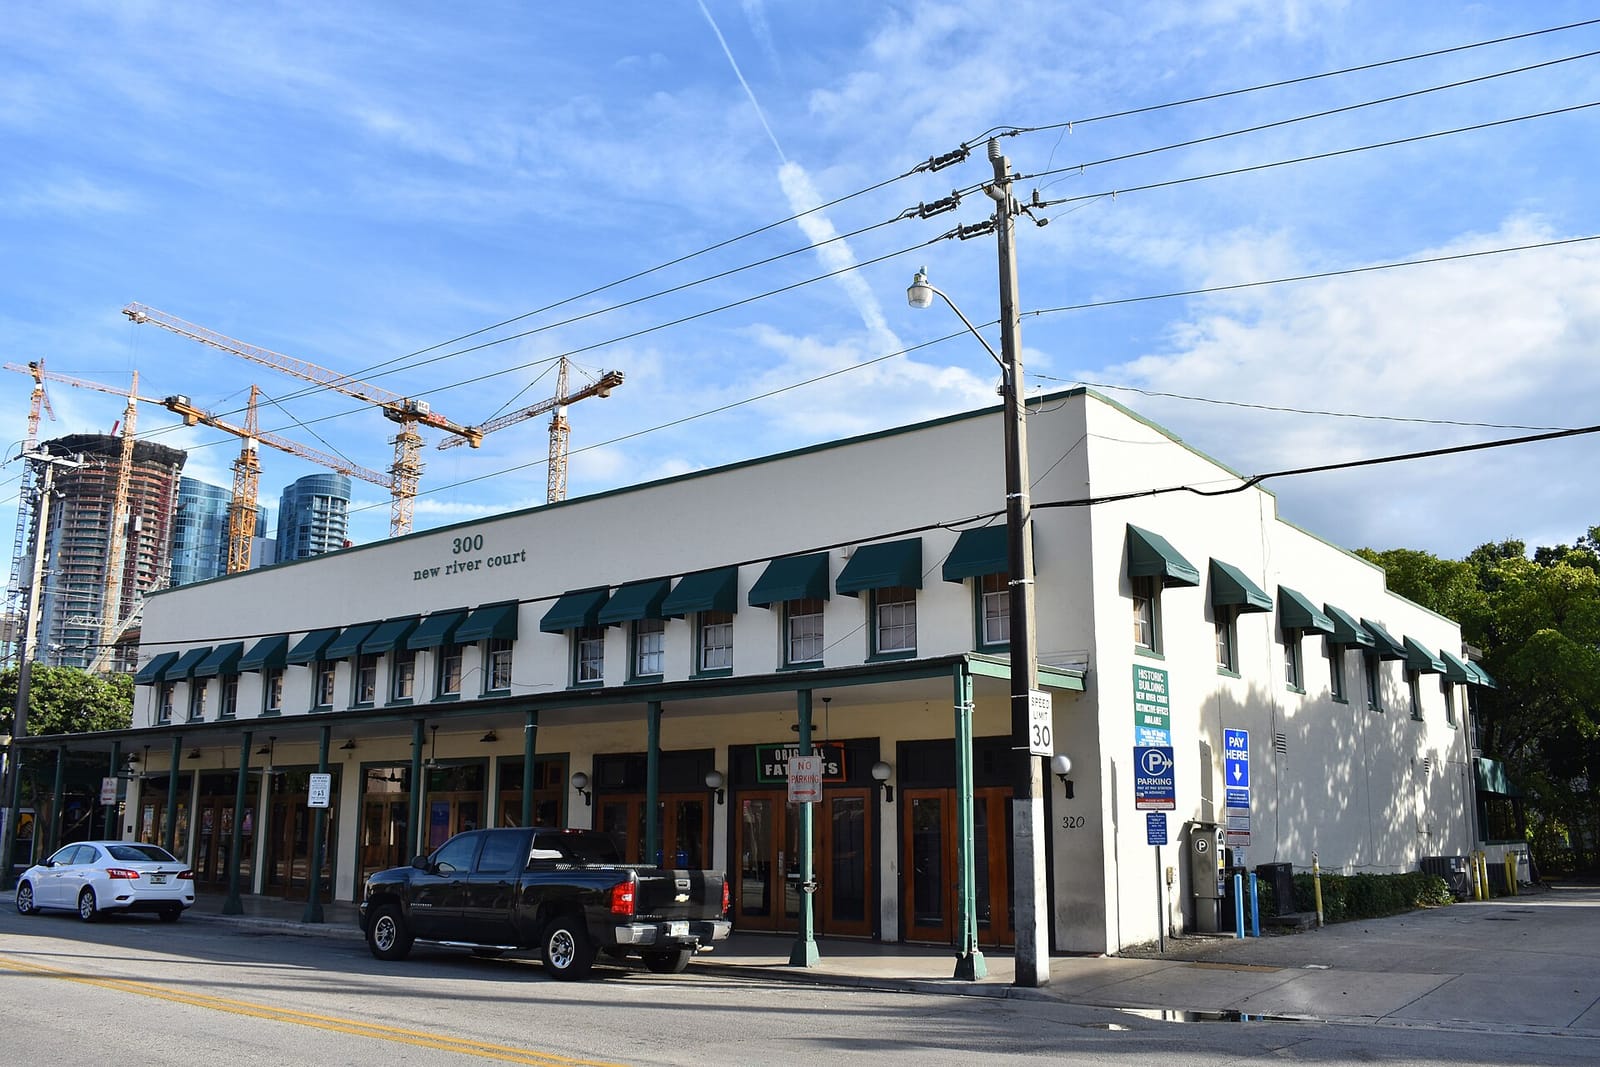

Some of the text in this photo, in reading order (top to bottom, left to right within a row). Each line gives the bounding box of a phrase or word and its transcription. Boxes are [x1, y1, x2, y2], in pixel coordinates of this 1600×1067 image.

[452, 534, 483, 554] 300
[413, 548, 526, 581] new river court
[1138, 669, 1163, 682] HISTORIC
[1139, 680, 1164, 693] BUILDING
[1031, 697, 1048, 709] SPEED
[1033, 710, 1048, 721] LIMIT
[1033, 724, 1050, 747] 30
[1229, 737, 1244, 748] PAY
[775, 748, 826, 761] ORIGAL
[1226, 749, 1248, 761] HERE
[798, 761, 812, 770] NO
[791, 775, 819, 784] PARKING
[1062, 816, 1085, 829] 320
